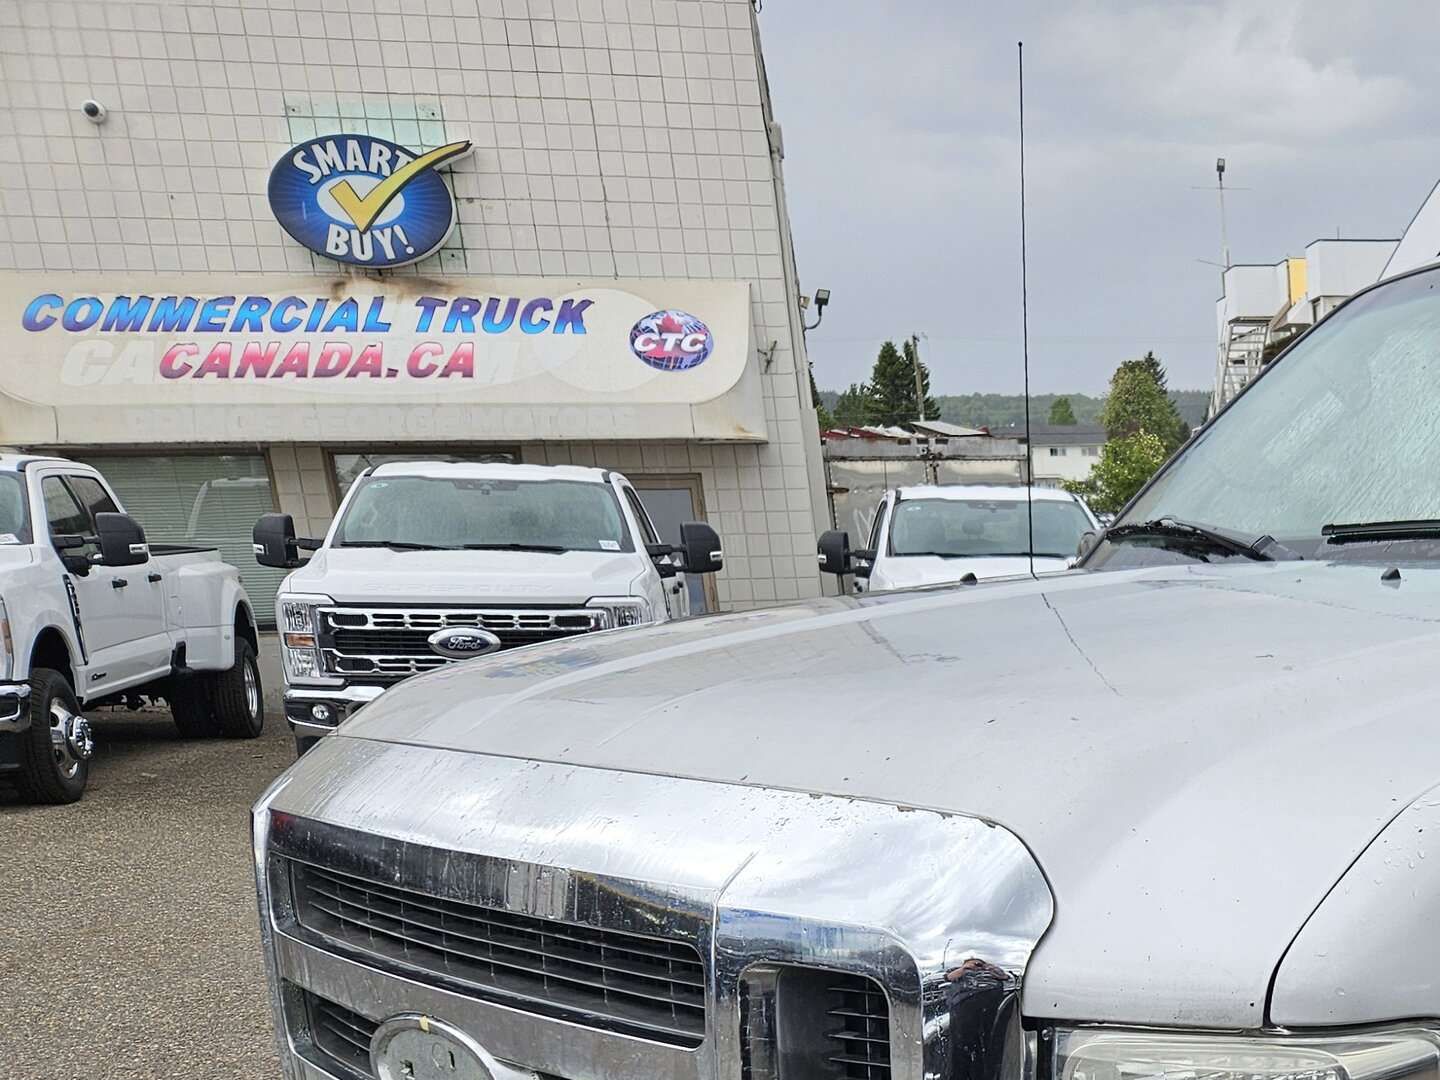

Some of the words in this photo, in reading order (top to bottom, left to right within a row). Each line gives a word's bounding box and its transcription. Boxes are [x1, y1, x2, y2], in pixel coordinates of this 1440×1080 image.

[292, 139, 414, 184] SMART
[325, 223, 415, 262] BUY!
[22, 292, 393, 334] COMMERCIAL
[414, 295, 596, 336] TRUCK
[158, 340, 476, 381] CANADA.CA
[633, 332, 708, 353] CTC
[447, 636, 481, 650] Ford
